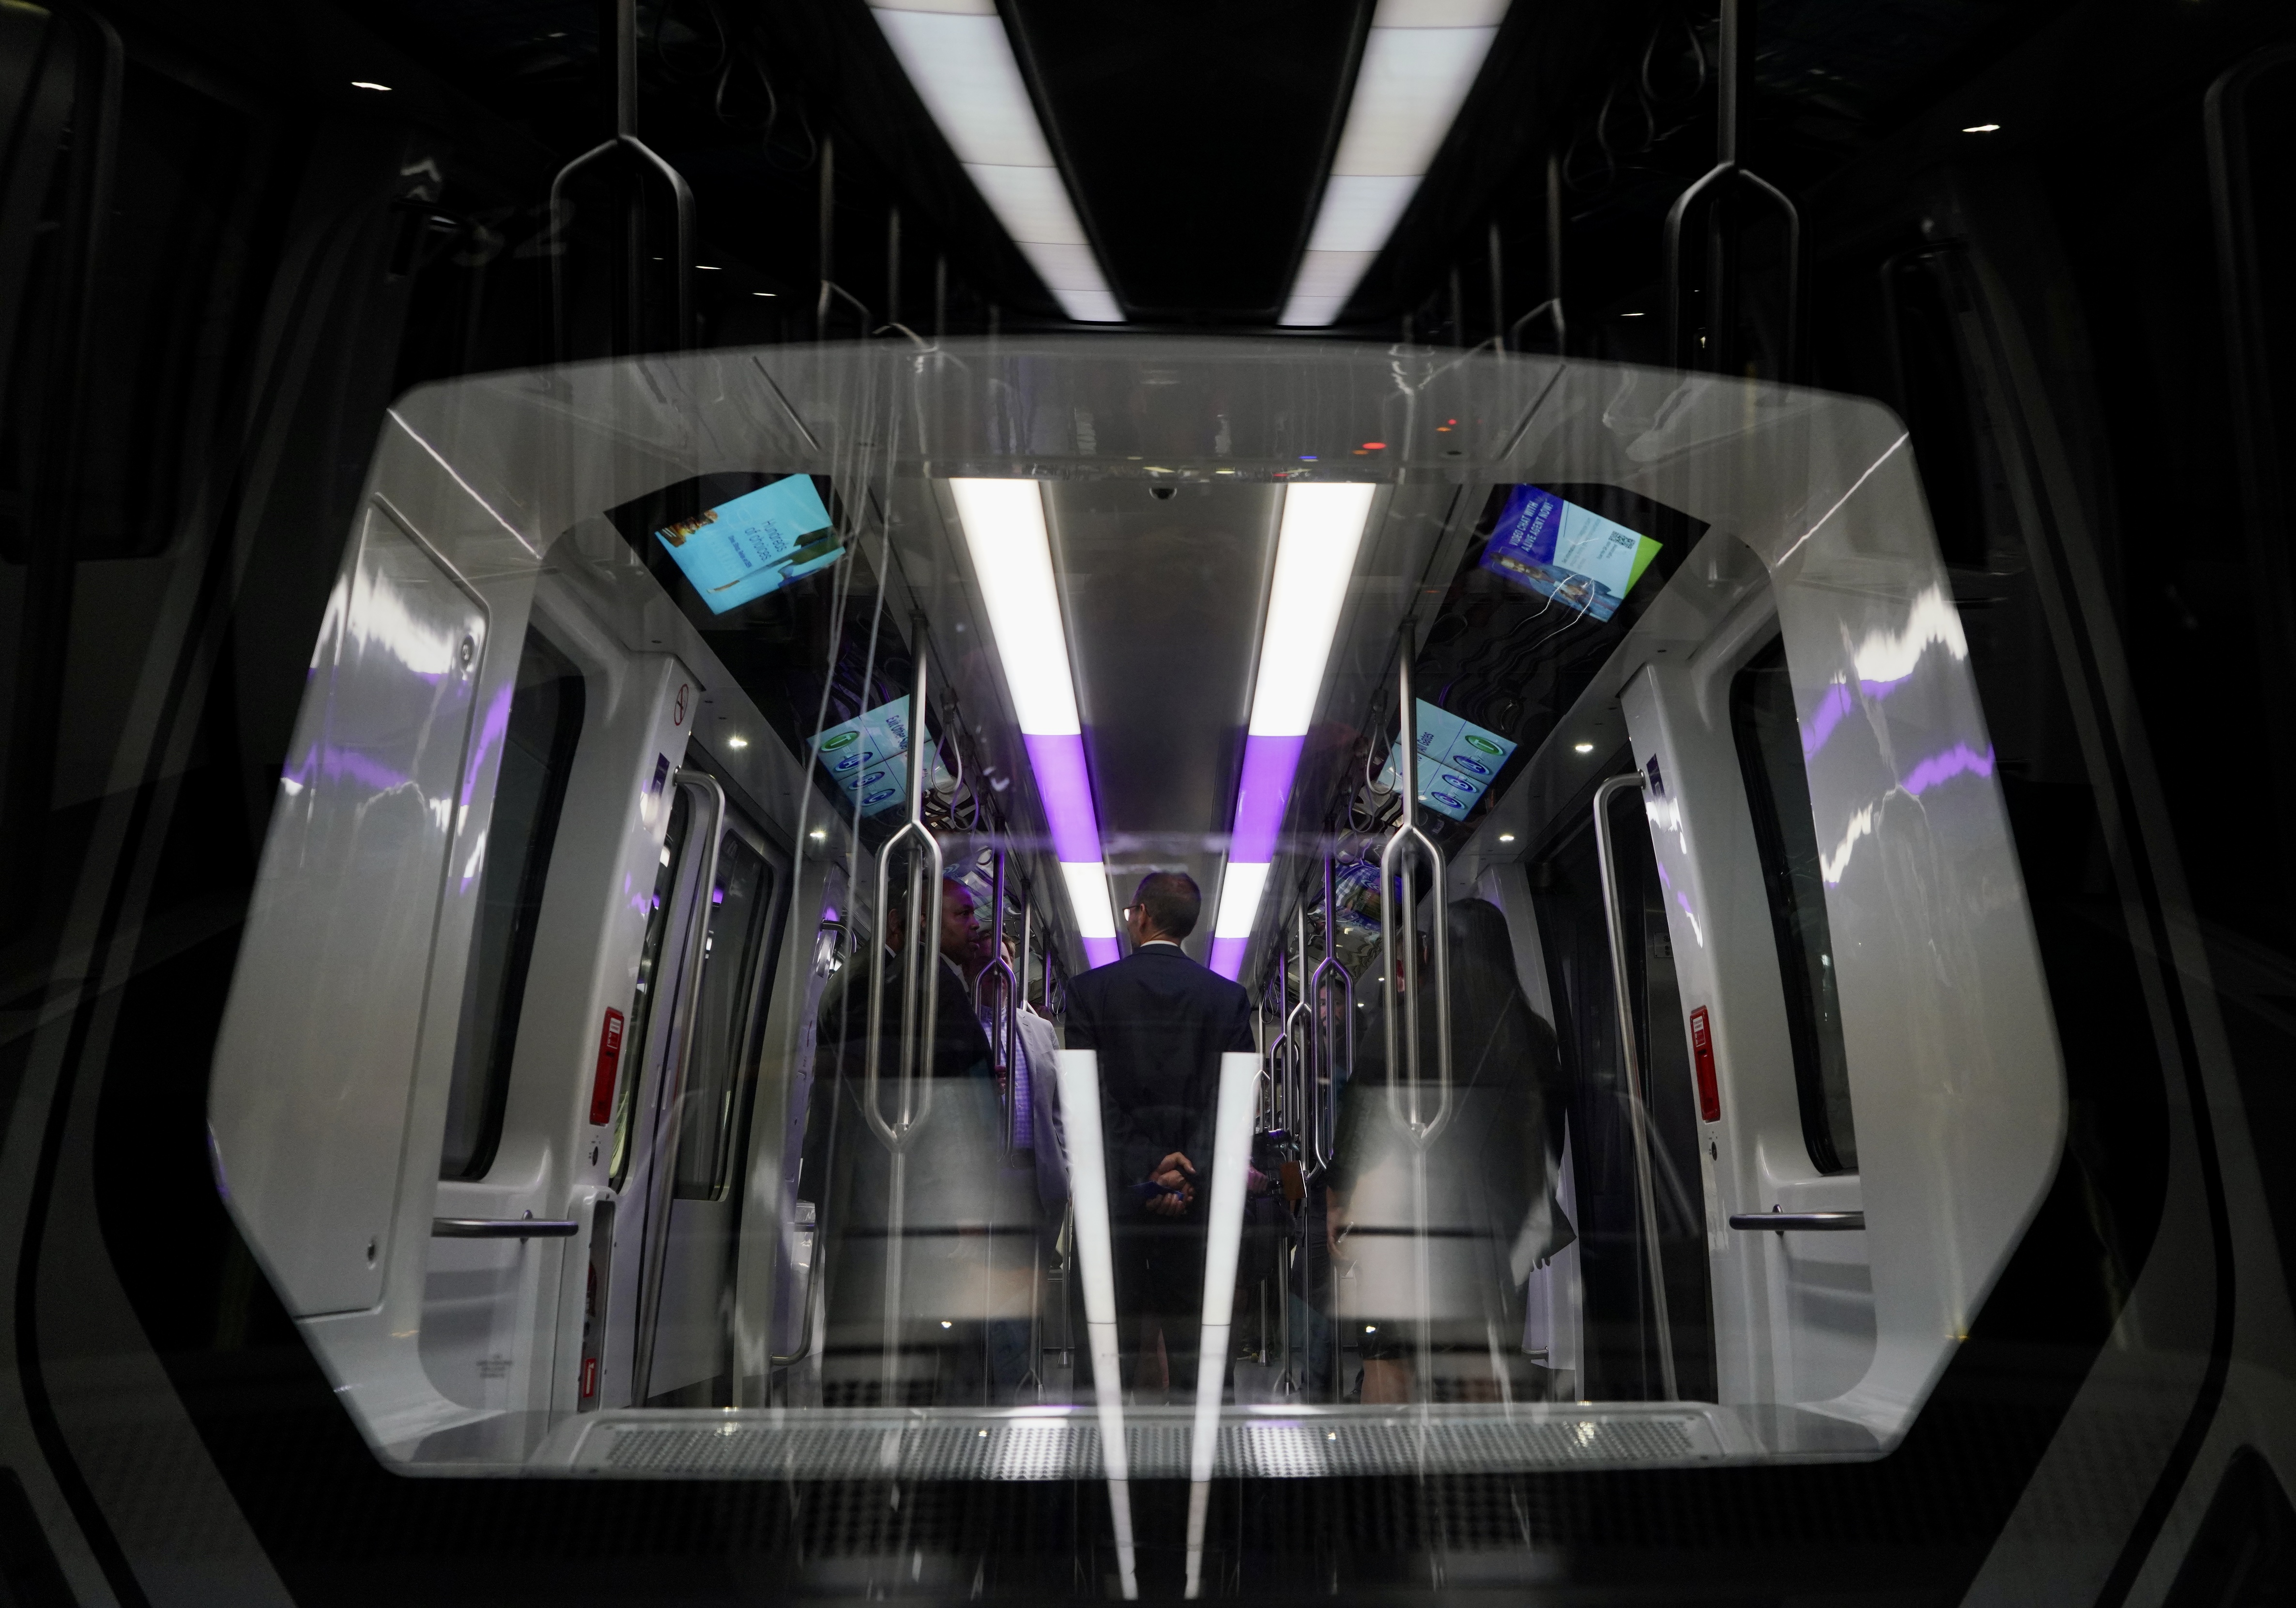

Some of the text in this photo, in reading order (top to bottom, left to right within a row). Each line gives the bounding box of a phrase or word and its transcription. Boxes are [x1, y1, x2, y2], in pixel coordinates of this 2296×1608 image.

[761, 519, 789, 552] Hundreds
[1509, 500, 1539, 546] VIDEO CHAT WITH
[1523, 534, 1536, 548] LIVE
[1530, 516, 1546, 536] AGENT
[1538, 501, 1553, 519] NOW!
[745, 527, 771, 561] of choices
[886, 715, 902, 728] Exit
[891, 724, 907, 739] Other
[1417, 732, 1435, 746] Gates
[830, 735, 852, 747] T
[856, 775, 876, 787] B
[869, 792, 888, 802] C
[1439, 739, 1495, 805] C B A T
